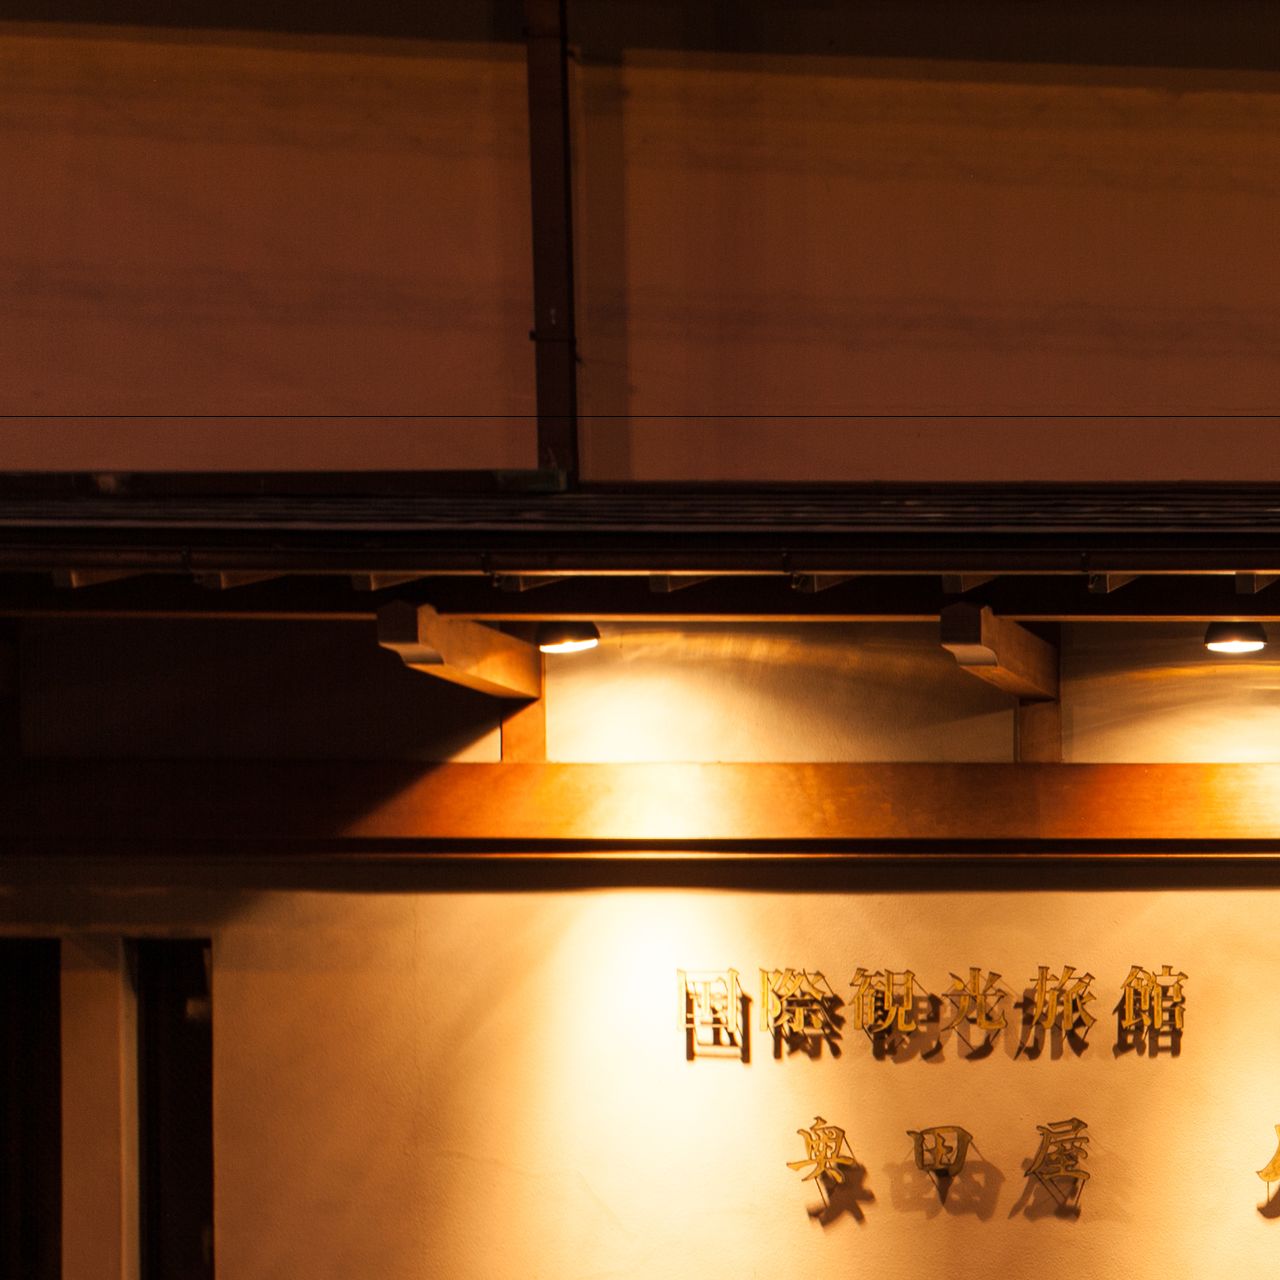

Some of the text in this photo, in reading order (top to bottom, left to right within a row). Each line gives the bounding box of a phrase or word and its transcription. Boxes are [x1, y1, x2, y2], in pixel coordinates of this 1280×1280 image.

[676, 965, 1189, 1033] 国際観光旅館
[786, 1116, 1092, 1184] 奥田屋
